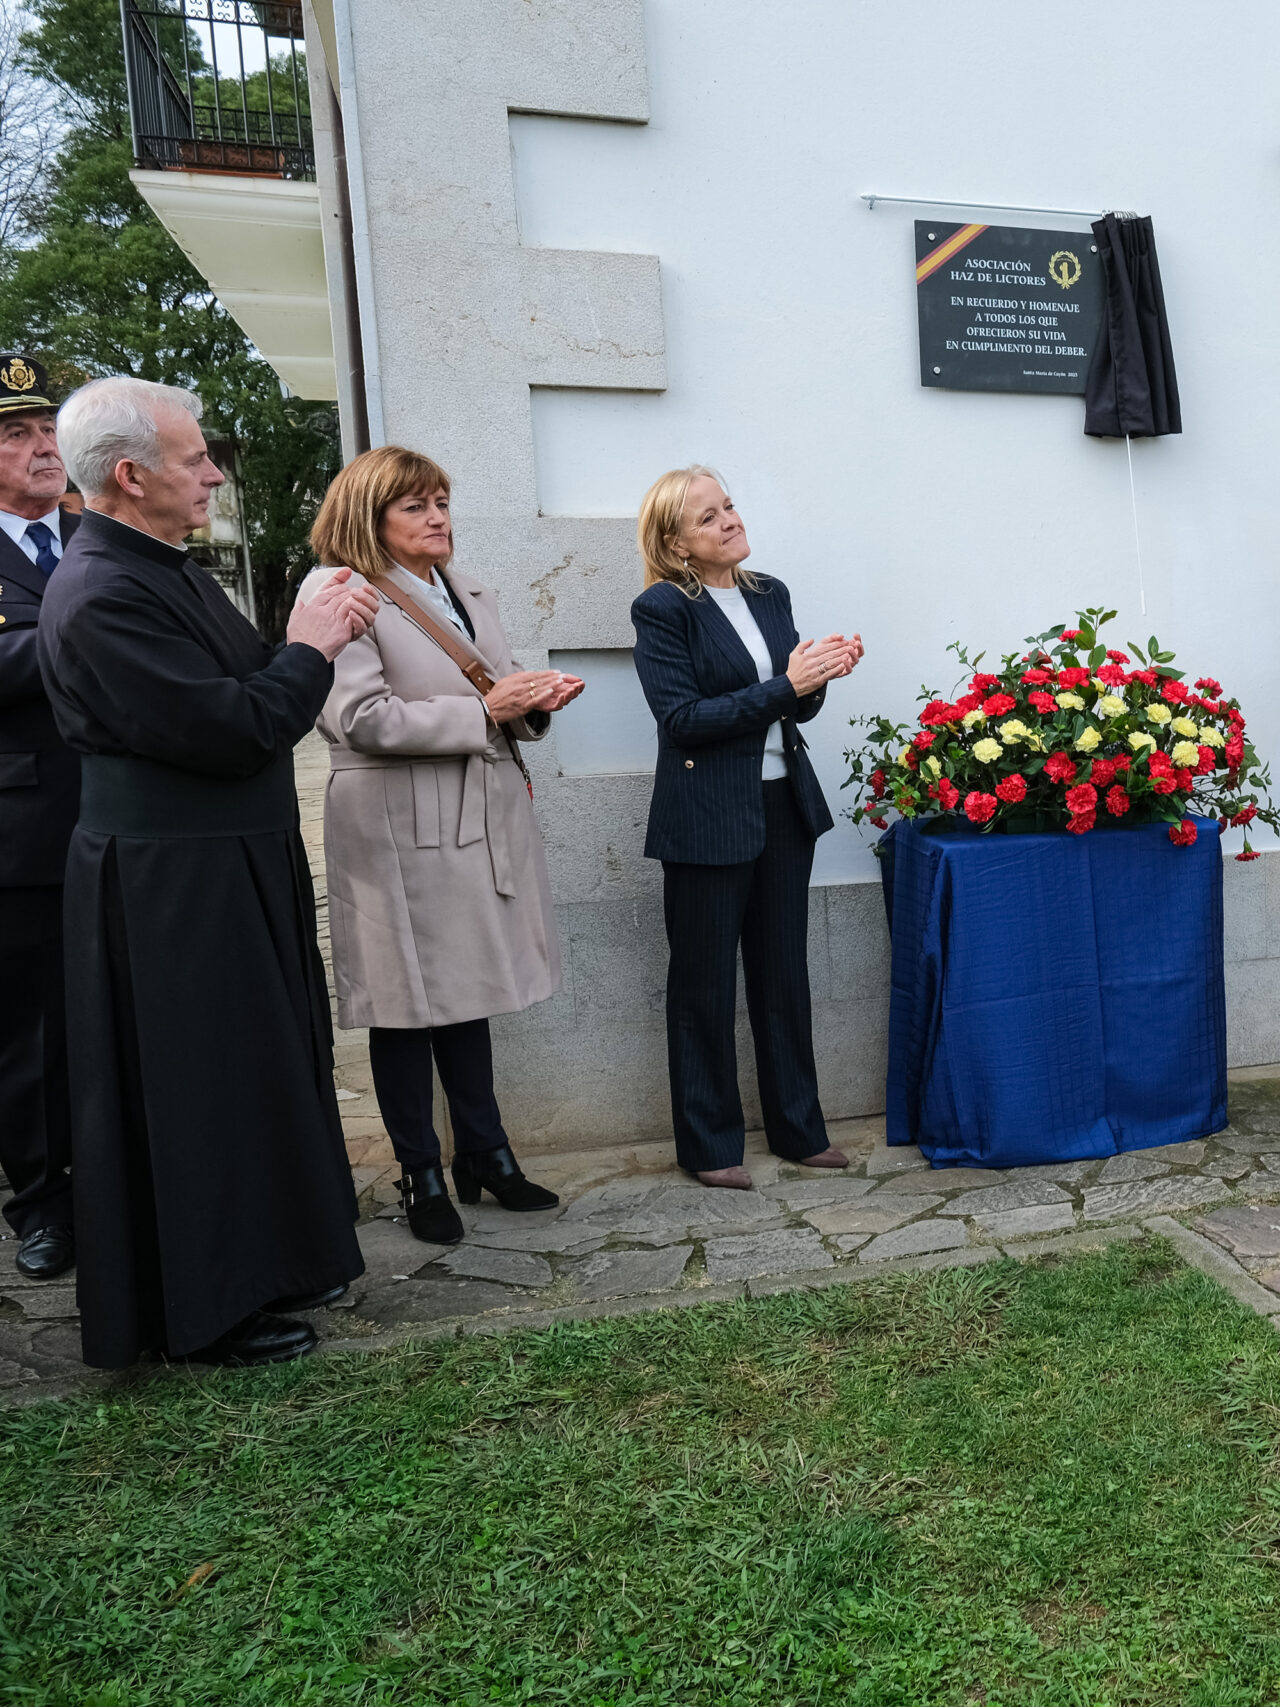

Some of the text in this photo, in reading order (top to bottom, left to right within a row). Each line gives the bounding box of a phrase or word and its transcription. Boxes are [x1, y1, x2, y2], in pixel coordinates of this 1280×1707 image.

[964, 258, 1031, 272] ASOCIACIÓN
[950, 270, 1047, 286] HAZ DE LICTORES
[950, 296, 1080, 313] EN RECUERDO Y HOMENAJE
[974, 312, 1059, 327] A TODOS LOS QUE
[966, 326, 1067, 341] OFRECIERON SU VIDA
[945, 340, 1088, 357] EN CUMPLIMENTO DEL DEBER.
